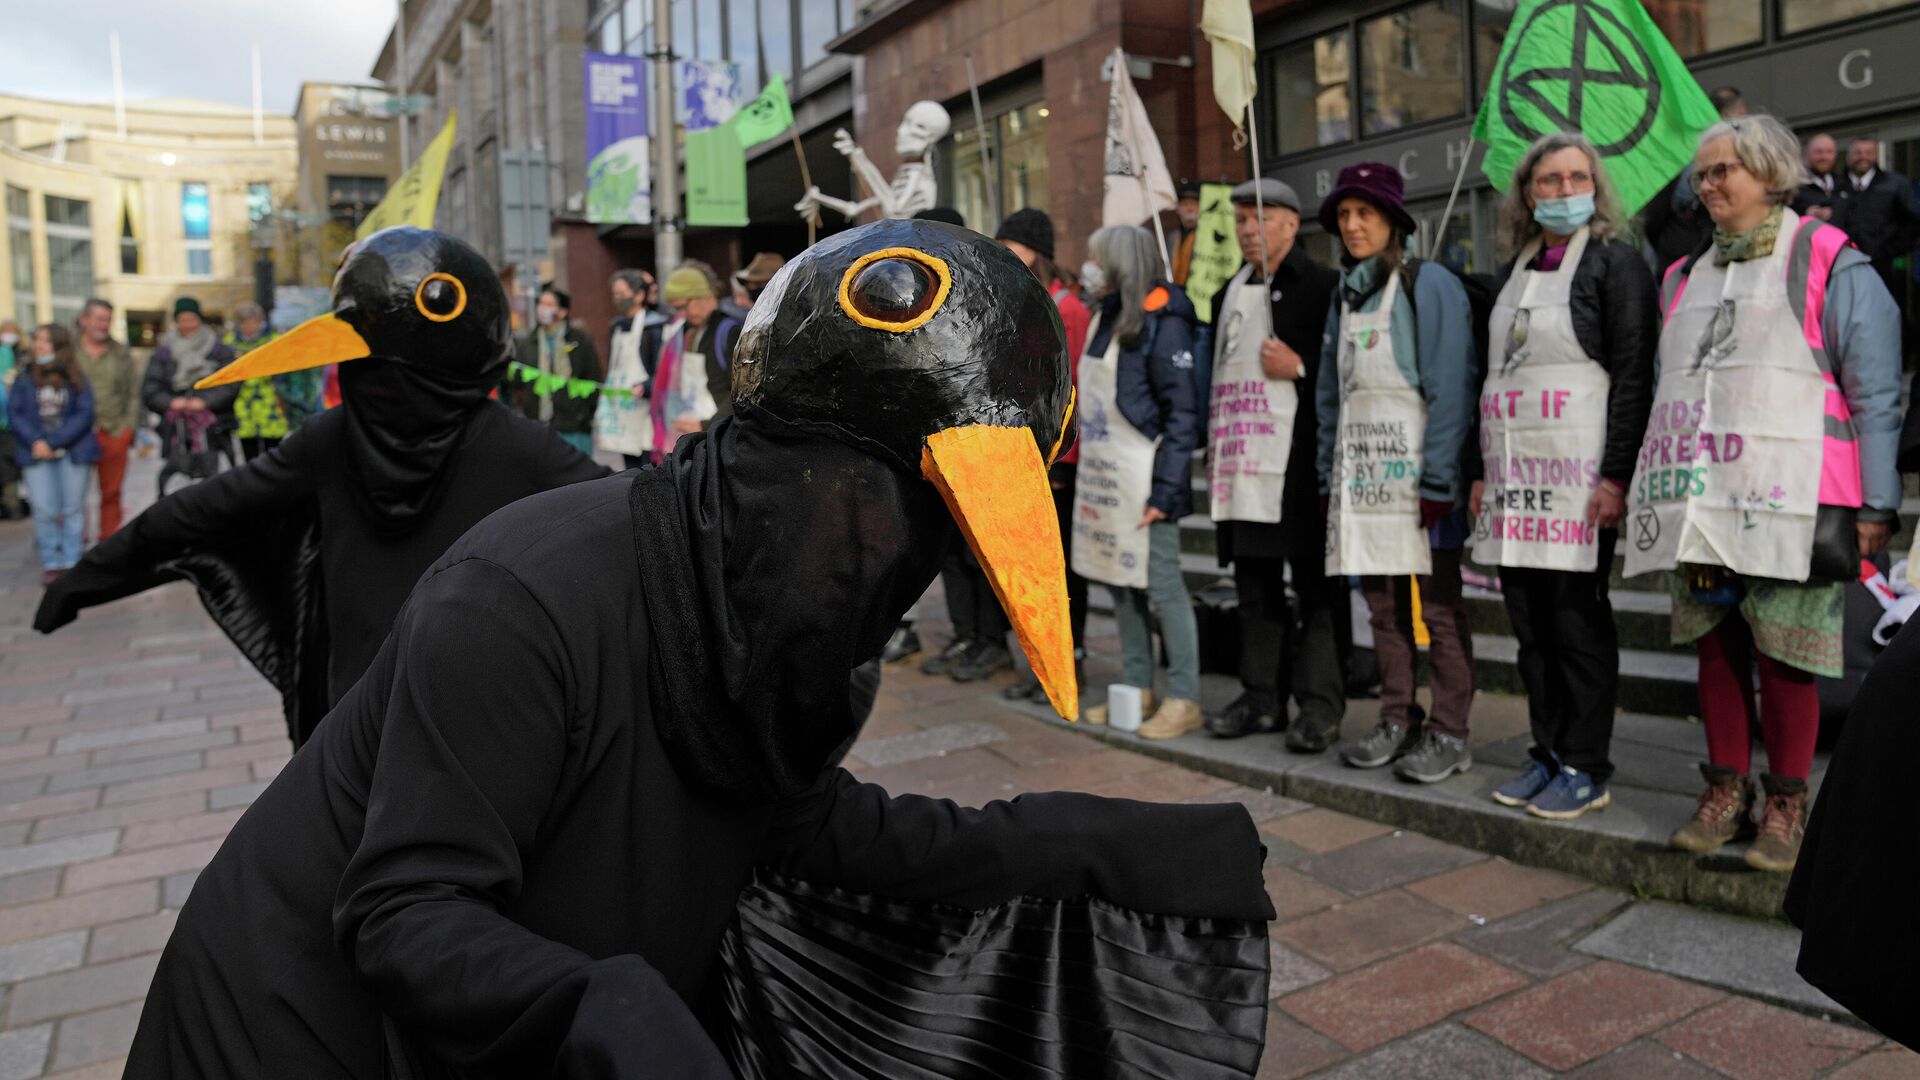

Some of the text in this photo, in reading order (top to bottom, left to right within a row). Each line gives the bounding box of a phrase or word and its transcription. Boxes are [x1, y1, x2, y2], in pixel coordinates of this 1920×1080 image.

[1838, 49, 1873, 89] G
[315, 123, 387, 142] LEWIS
[1541, 389, 1571, 418] IF
[1376, 439, 1409, 456] HAS
[1640, 432, 1744, 473] SPREAD
[1355, 462, 1376, 480] BY
[1637, 467, 1708, 504] SEEDS
[1495, 488, 1553, 511] WERE
